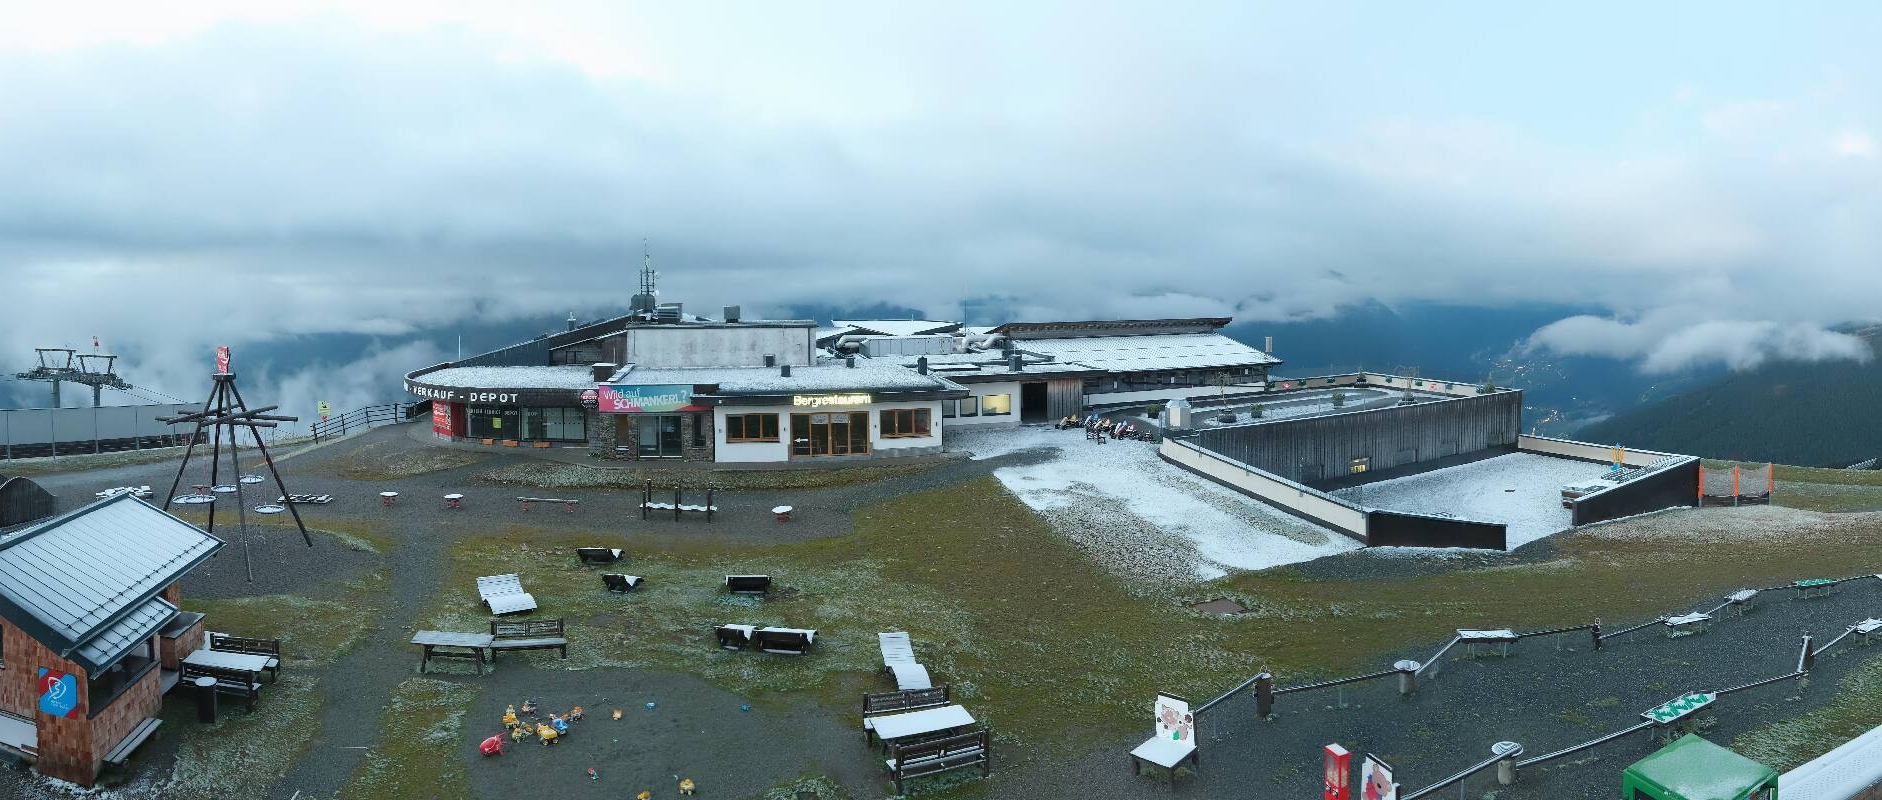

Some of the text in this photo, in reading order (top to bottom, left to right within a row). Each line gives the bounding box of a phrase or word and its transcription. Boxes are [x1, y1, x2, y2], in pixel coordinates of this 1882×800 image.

[413, 386, 455, 400] VERKAUF
[470, 393, 519, 403] DEPOT
[603, 387, 641, 400] Wild auf
[793, 394, 872, 407] Bergrestaurant
